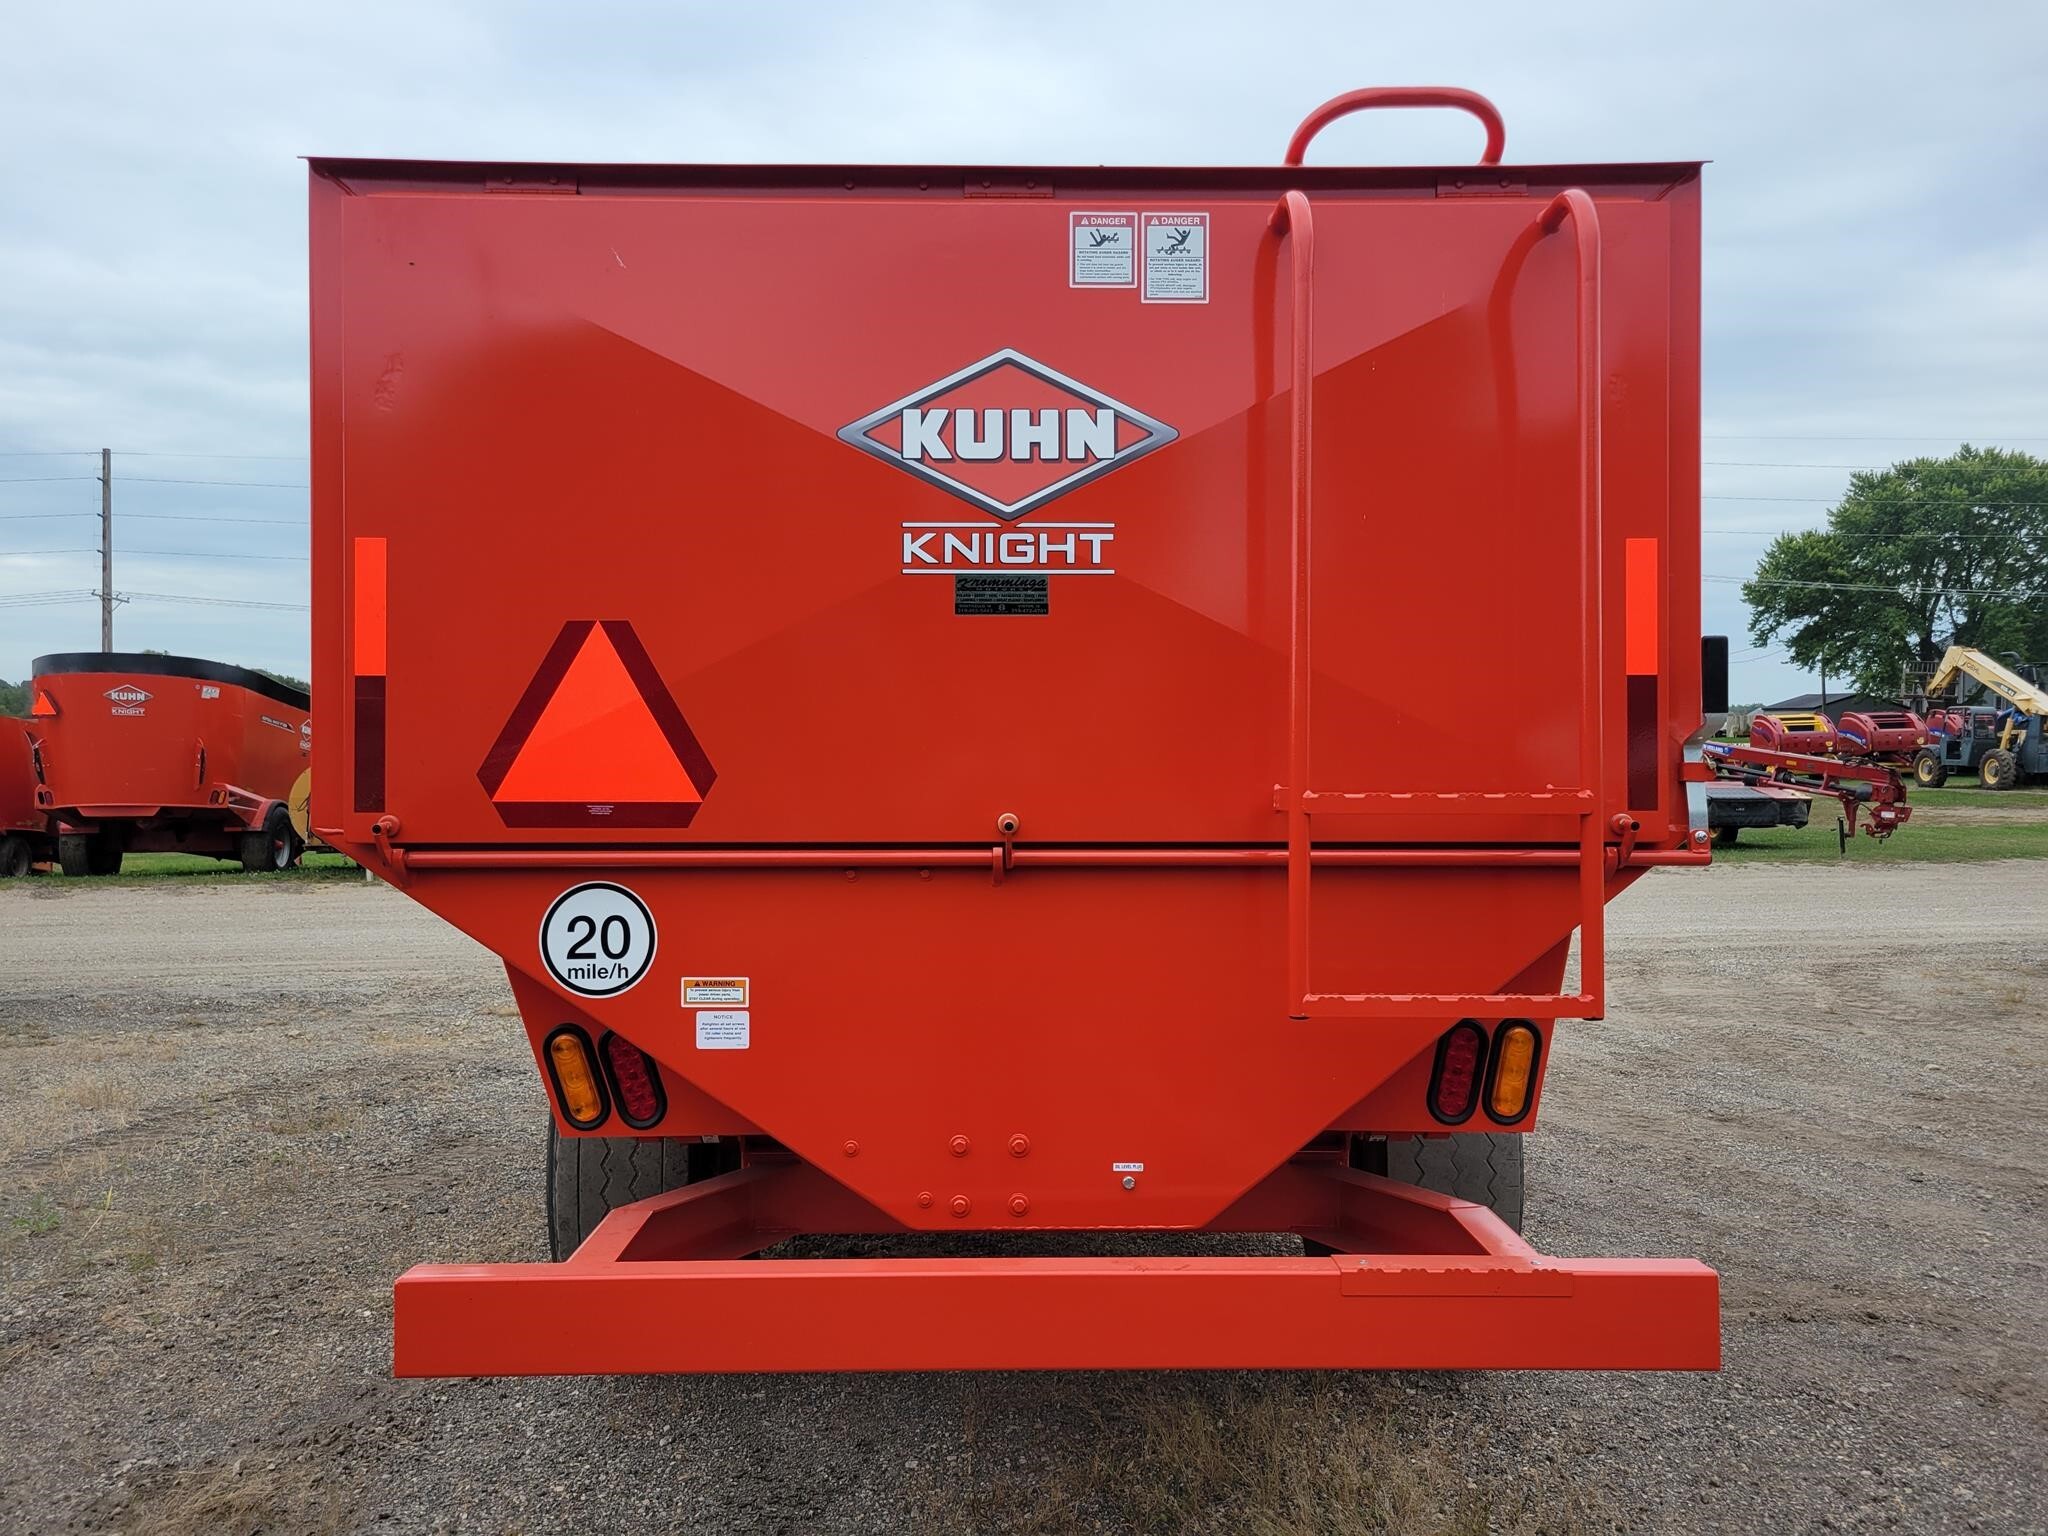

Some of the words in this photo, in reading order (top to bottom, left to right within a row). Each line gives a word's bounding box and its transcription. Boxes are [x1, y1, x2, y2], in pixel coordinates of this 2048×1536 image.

[1090, 217, 1127, 225] DANGER
[1161, 216, 1200, 225] DANGER
[901, 408, 1116, 461] KUHN
[902, 532, 1115, 564] KNIGHT
[111, 691, 145, 701] KUHN
[566, 914, 631, 960] 20
[567, 963, 629, 980] mile/h
